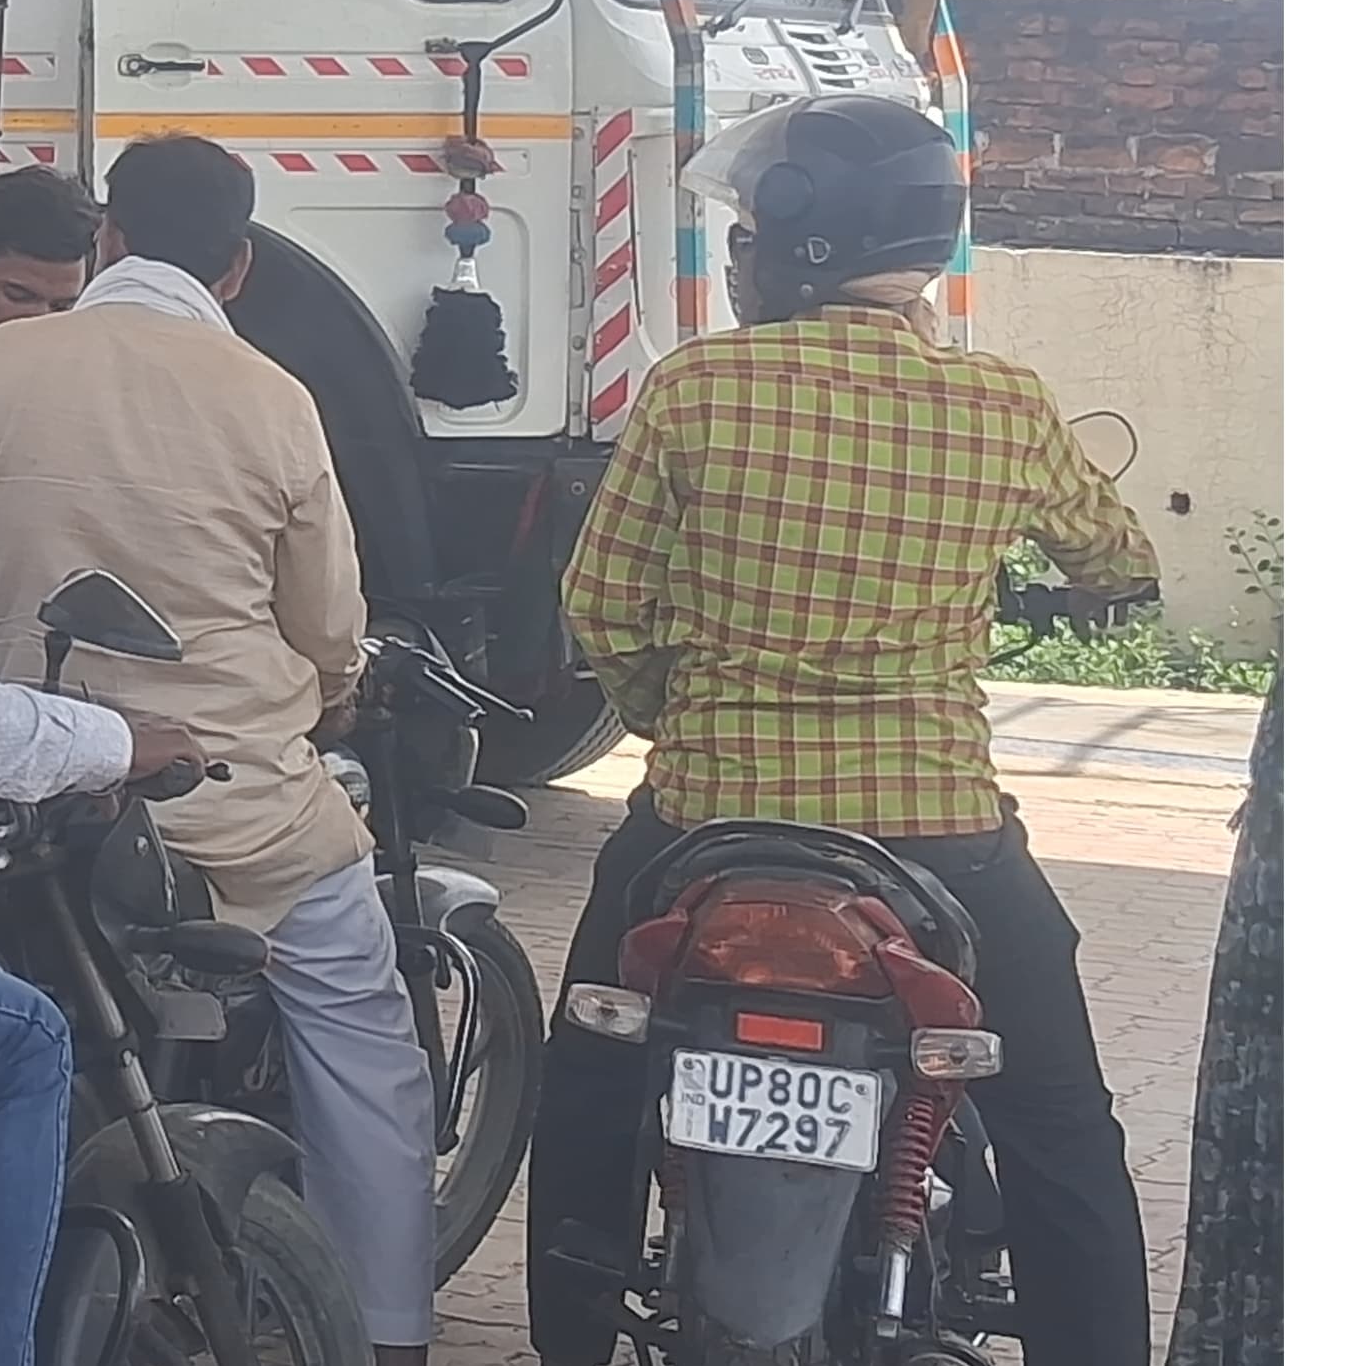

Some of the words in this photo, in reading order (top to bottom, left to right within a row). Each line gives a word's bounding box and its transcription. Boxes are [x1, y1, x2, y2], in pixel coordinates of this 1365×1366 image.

[681, 1092, 706, 1107] IND
[709, 1058, 853, 1115] UP80C
[706, 1102, 853, 1158] W7297
